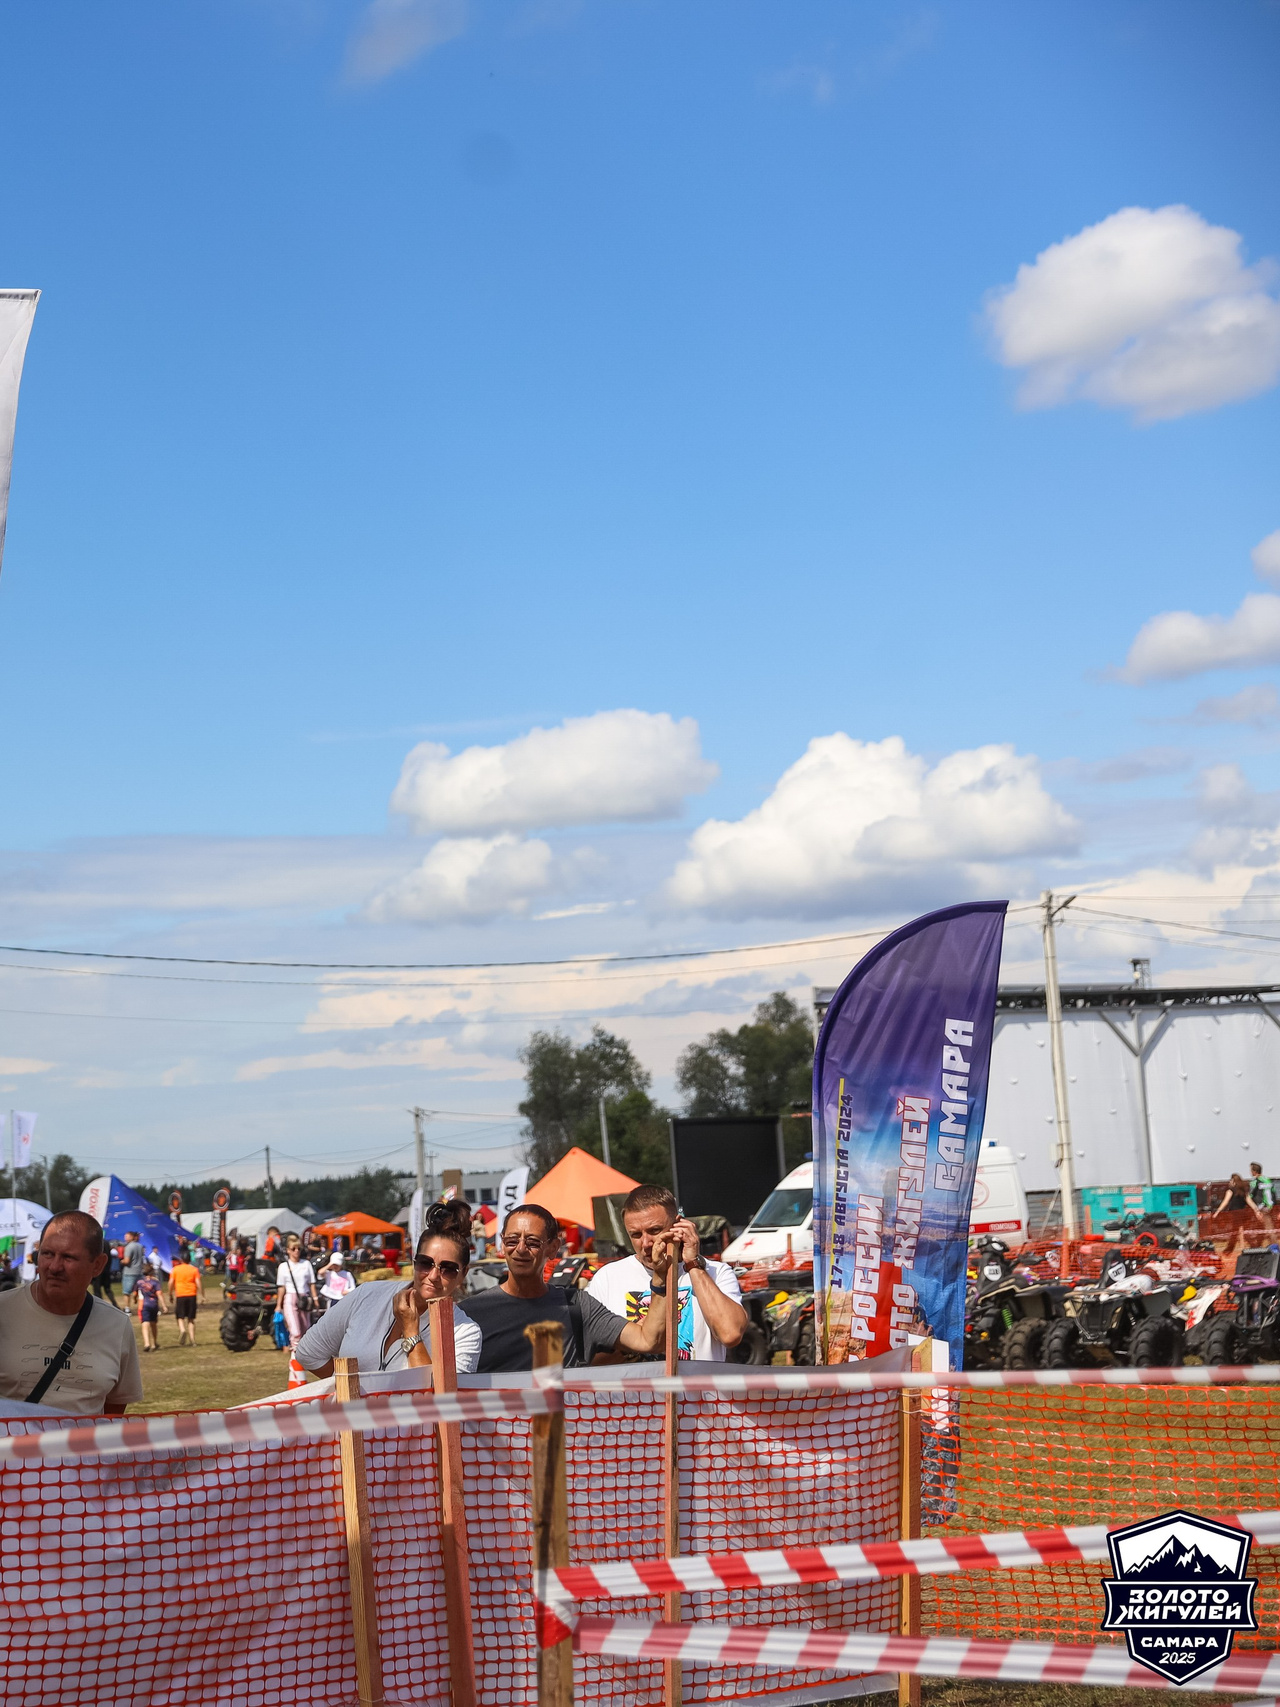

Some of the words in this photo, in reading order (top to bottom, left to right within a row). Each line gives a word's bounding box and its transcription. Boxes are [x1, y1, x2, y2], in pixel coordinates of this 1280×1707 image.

[837, 1093, 855, 1143] 2024
[933, 1017, 975, 1193] САМАРА
[834, 1149, 850, 1227] АВГУСТА
[892, 1094, 932, 1270] ЖИГУЛЕЙ
[830, 1233, 845, 1289] 17-18
[850, 1193, 885, 1342] РОССИИ
